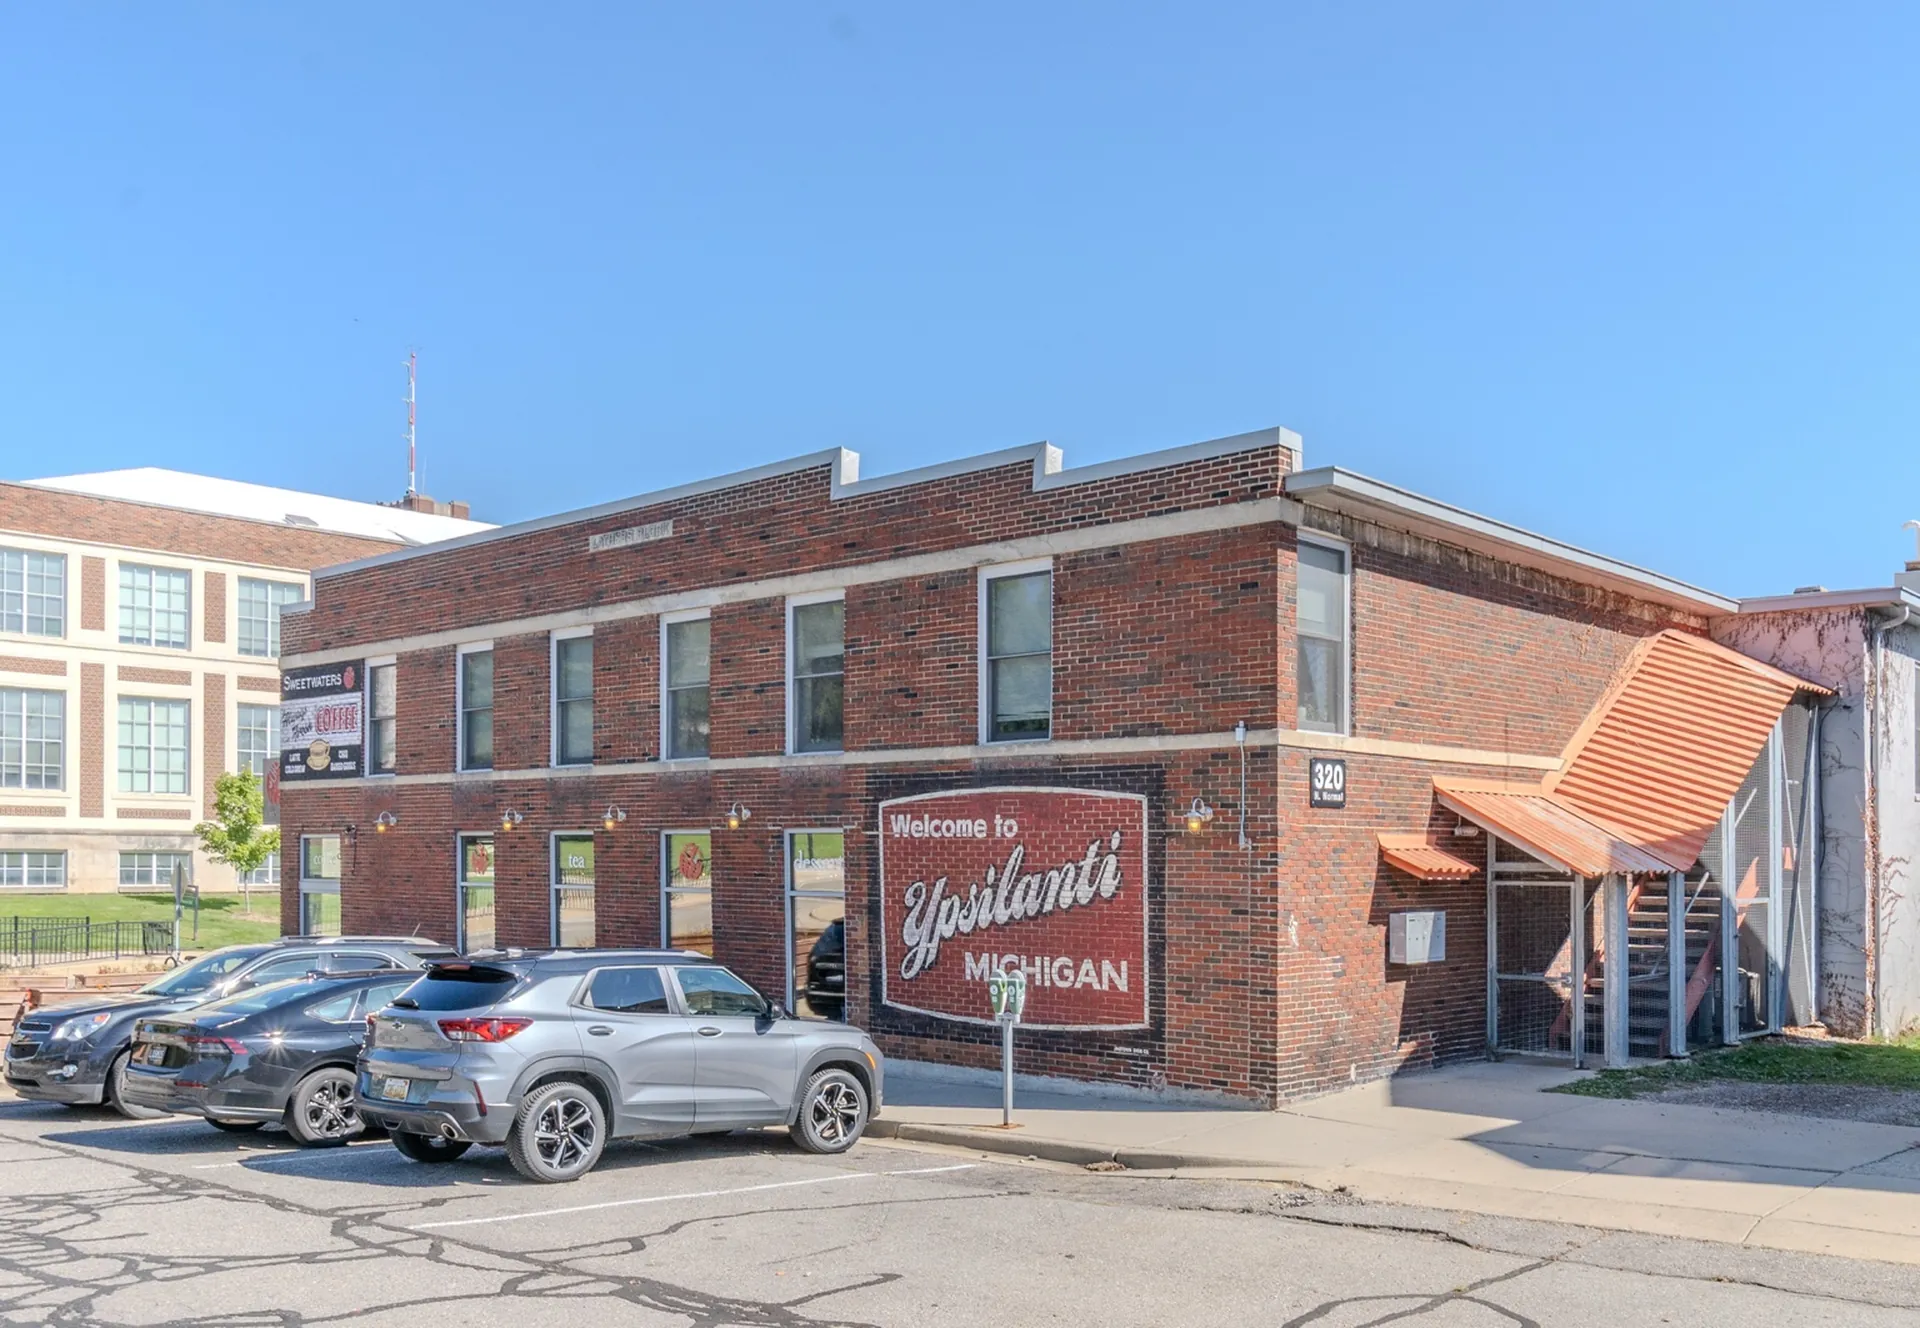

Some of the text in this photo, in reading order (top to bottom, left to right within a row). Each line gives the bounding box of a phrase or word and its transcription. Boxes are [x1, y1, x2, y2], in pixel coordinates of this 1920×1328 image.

[284, 673, 342, 691] SWEETWATERS
[316, 704, 358, 734] COFFEE
[1314, 763, 1344, 790] 320
[890, 814, 1018, 838] Welcome to
[568, 854, 585, 868] tea
[900, 830, 1121, 980] Ypsilanti
[964, 951, 1129, 992] MICHIGAN
